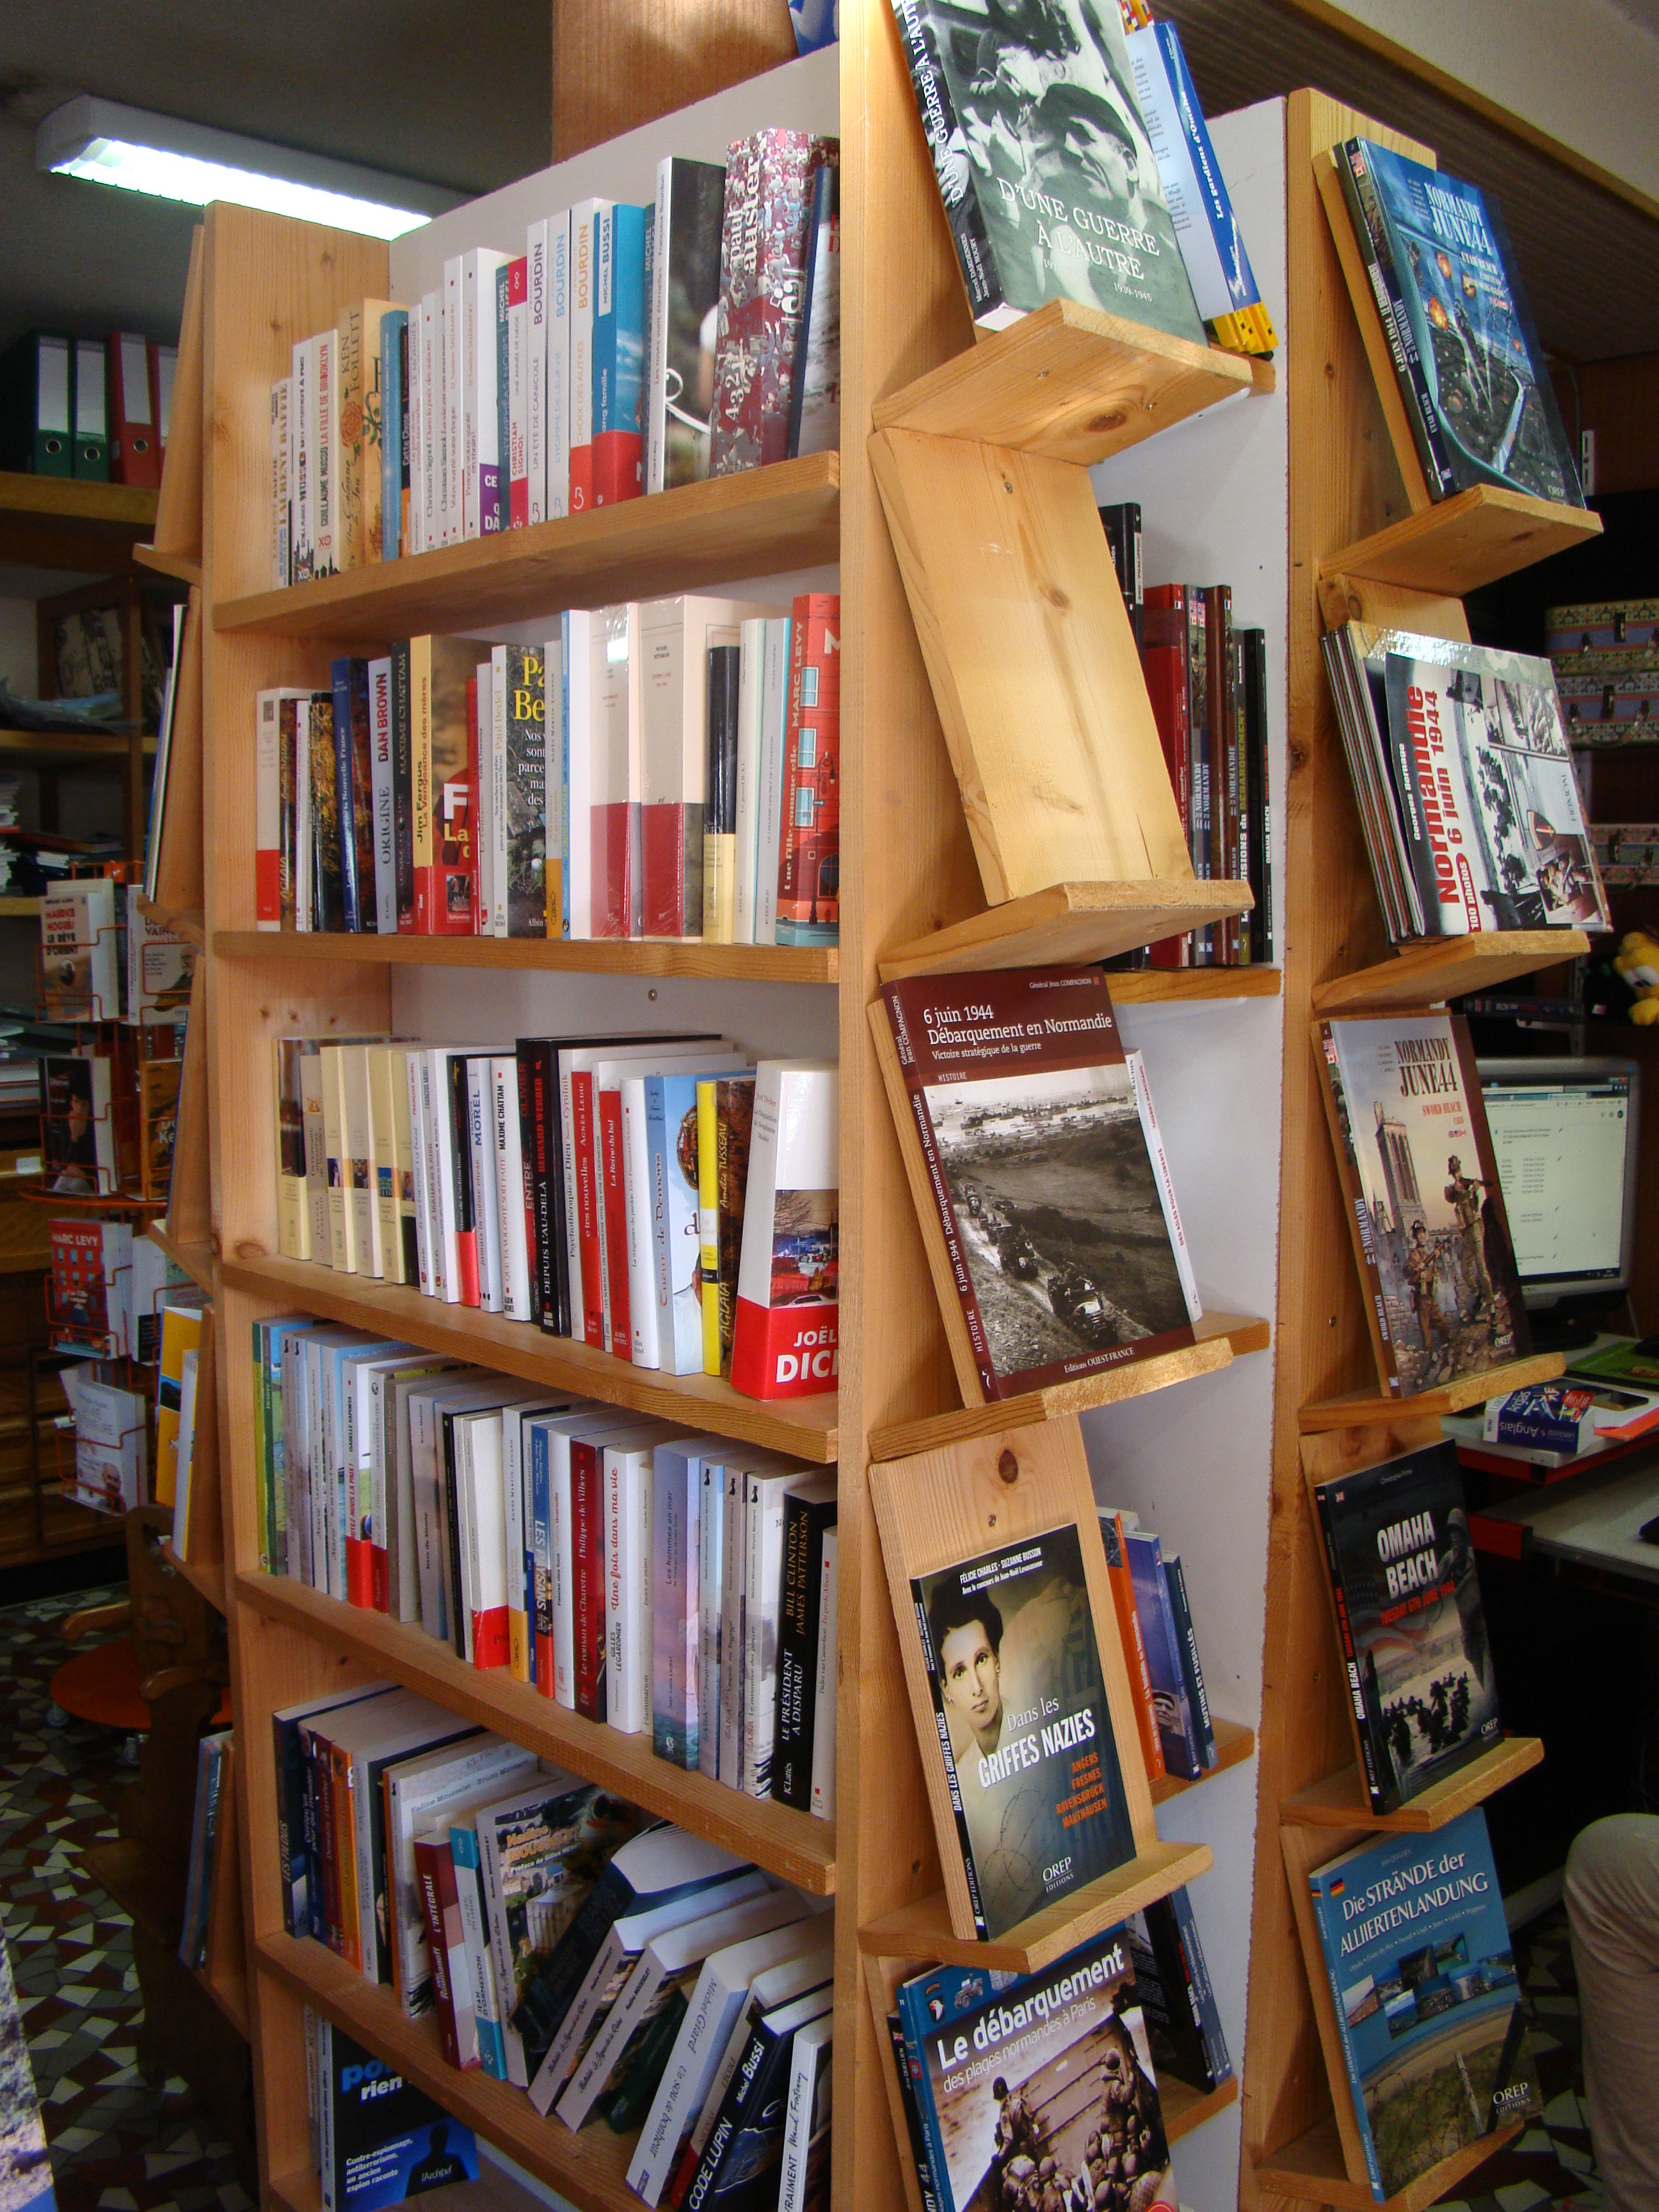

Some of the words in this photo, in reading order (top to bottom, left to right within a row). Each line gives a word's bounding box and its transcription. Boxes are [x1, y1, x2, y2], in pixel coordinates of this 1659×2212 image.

[920, 68, 948, 145] GUERRE
[1198, 146, 1218, 196] gardiens
[744, 159, 760, 275] auster
[997, 177, 1068, 222] D'UNE
[1073, 207, 1159, 256] GUERRE
[1423, 182, 1484, 227] NORMANDY
[602, 217, 611, 263] BUSSI
[730, 209, 745, 271] paul
[1037, 220, 1052, 249] À
[1057, 232, 1144, 280] L'AUTRE
[534, 242, 543, 325] BOURDIN
[556, 234, 565, 317] BOURDIN
[579, 224, 588, 309] BOURDIN
[1114, 282, 1152, 303] 1939-1945
[341, 335, 349, 375] KEN
[349, 312, 360, 392] FOLLETT
[793, 621, 803, 675] LEVY
[376, 673, 388, 728] BROWN
[494, 689, 502, 722] Bedel
[792, 685, 801, 728] MARC
[525, 730, 541, 741] Nos
[1425, 691, 1444, 755] 1944
[378, 731, 389, 763] DAN
[1407, 685, 1460, 904] Normandie
[1438, 767, 1458, 819] juin
[1560, 773, 1576, 822] HEIMDAL
[380, 787, 391, 865] ORIGINE
[1447, 828, 1463, 844] 6
[1459, 862, 1476, 902] photos
[1468, 904, 1479, 930] 100
[47, 934, 54, 943] LE
[1060, 978, 1091, 986] COMPAGNON
[892, 995, 910, 1043] COMPAGNON
[923, 1009, 932, 1024] 6
[934, 1007, 961, 1028] juin
[963, 1004, 994, 1021] 1944
[927, 1023, 1025, 1045] Débarquement
[1027, 1023, 1043, 1036] en
[1043, 1013, 1112, 1034] Normandie
[932, 1050, 959, 1060] Victoire
[961, 1046, 1000, 1058] stratégique
[1001, 1045, 1009, 1054] de
[1011, 1043, 1018, 1052] la
[1020, 1042, 1041, 1054] guerre
[1395, 1038, 1450, 1064] NORMANDY
[938, 1072, 967, 1082] HISTOIRE
[535, 1077, 544, 1121] WERBER
[561, 1074, 570, 1121] Cyrulnik
[1422, 1104, 1442, 1116] SWORD
[1442, 1102, 1461, 1114] BEACH
[474, 1089, 483, 1146] MOREL
[913, 1094, 931, 1150] Normandie
[498, 1123, 506, 1150] MAXIME
[537, 1124, 546, 1173] BERNARD
[522, 1161, 534, 1210] ENTRE
[581, 1157, 589, 1213] nouvelles
[930, 1166, 954, 1235] Débarquement
[538, 1182, 549, 1255] L'AU-DELÀ
[567, 1183, 576, 1258] Psychothérapie
[76, 1234, 99, 1248] LEVY
[950, 1240, 960, 1262] 1944
[543, 1258, 552, 1295] DEPUIS
[955, 1262, 968, 1283] juin
[960, 1284, 968, 1292] 6
[794, 1326, 837, 1347] JOËL
[966, 1309, 983, 1352] HISTOIRE
[1064, 1361, 1087, 1374] Editions
[1087, 1347, 1134, 1366] OUEST-FRANCE
[1500, 1422, 1539, 1437] Anglais
[610, 1518, 618, 1550] dans
[796, 1511, 808, 1592] PATTERSON
[1377, 1511, 1436, 1562] OMAHA
[787, 1521, 797, 1587] CLINTON
[959, 1569, 977, 1584] FÉLICIE
[977, 1562, 998, 1578] CHARLES
[1001, 1553, 1023, 1568] SUZANNE
[1022, 1547, 1041, 1561] BUSSON
[1386, 1548, 1439, 1599] BEACH
[610, 1582, 619, 1611] Une
[785, 1591, 795, 1617] BILL
[1380, 1602, 1407, 1626] TUESDAY
[1408, 1596, 1421, 1613] 6TH
[1423, 1587, 1439, 1606] JUNE
[1439, 1580, 1455, 1598] 1944
[796, 1595, 806, 1636] JAMES
[1187, 1628, 1200, 1676] FUSILLÉS
[781, 1648, 793, 1721] PRÉSIDENT
[794, 1664, 804, 1720] DISPARU
[1347, 1662, 1359, 1688] BEACH
[936, 1712, 951, 1740] NAZIES
[1007, 1707, 1039, 1732] Dans
[1039, 1697, 1059, 1717] les
[1200, 1693, 1210, 1729] MUTINS
[1481, 1717, 1498, 1735] OREP
[781, 1724, 790, 1741] LE
[978, 1733, 1039, 1788] GRIFFES
[1041, 1708, 1095, 1757] NAZIES
[944, 1740, 957, 1770] GRIFFES
[1072, 1752, 1098, 1774] ANGERS
[950, 1771, 959, 1789] LES
[1071, 1768, 1102, 1790] FRESNES
[952, 1790, 963, 1812] DANS
[1056, 1782, 1104, 1815] RAVENSBRÜCK
[1062, 1798, 1107, 1829] MAUTHAUSEN
[507, 1825, 549, 1847] Nadine
[509, 1827, 579, 1862] MOUSSELET
[1043, 1856, 1071, 1882] OREP
[1045, 1872, 1074, 1893] EDITIONS
[1343, 1896, 1366, 1921] Die
[1366, 1859, 1438, 1907] STRÄNDE
[1439, 1852, 1466, 1875] der
[422, 1873, 441, 1933] L'INTÉGRALE
[1341, 1873, 1488, 1957] ALLIIERTENLANDUNG
[476, 1955, 488, 2016] D'ORMESSON
[703, 1979, 717, 2016] Michel
[937, 2035, 968, 2070] Le
[973, 1943, 1125, 2049] débarquement
[687, 2016, 705, 2054] Giard
[943, 2072, 964, 2093] des
[965, 2051, 1002, 2085] plages
[1003, 2020, 1062, 2060] normandes
[1062, 2010, 1070, 2025] à
[1070, 1996, 1096, 2021] Paris
[741, 2038, 765, 2080] Bussi
[361, 2076, 403, 2101] rien
[736, 2079, 750, 2104] Michel
[1493, 2081, 1528, 2105] OREP
[1496, 2097, 1530, 2115] EDITIONS
[346, 2138, 413, 2166] Contre-espionnage,
[346, 2152, 397, 2174] antiterrorisme,
[688, 2163, 715, 2212] CODE
[707, 2117, 734, 2165] LUPIN
[346, 2179, 370, 2192] espion
[372, 2168, 398, 2183] raconte
[347, 2175, 356, 2184] un
[358, 2167, 381, 2180] ancien
